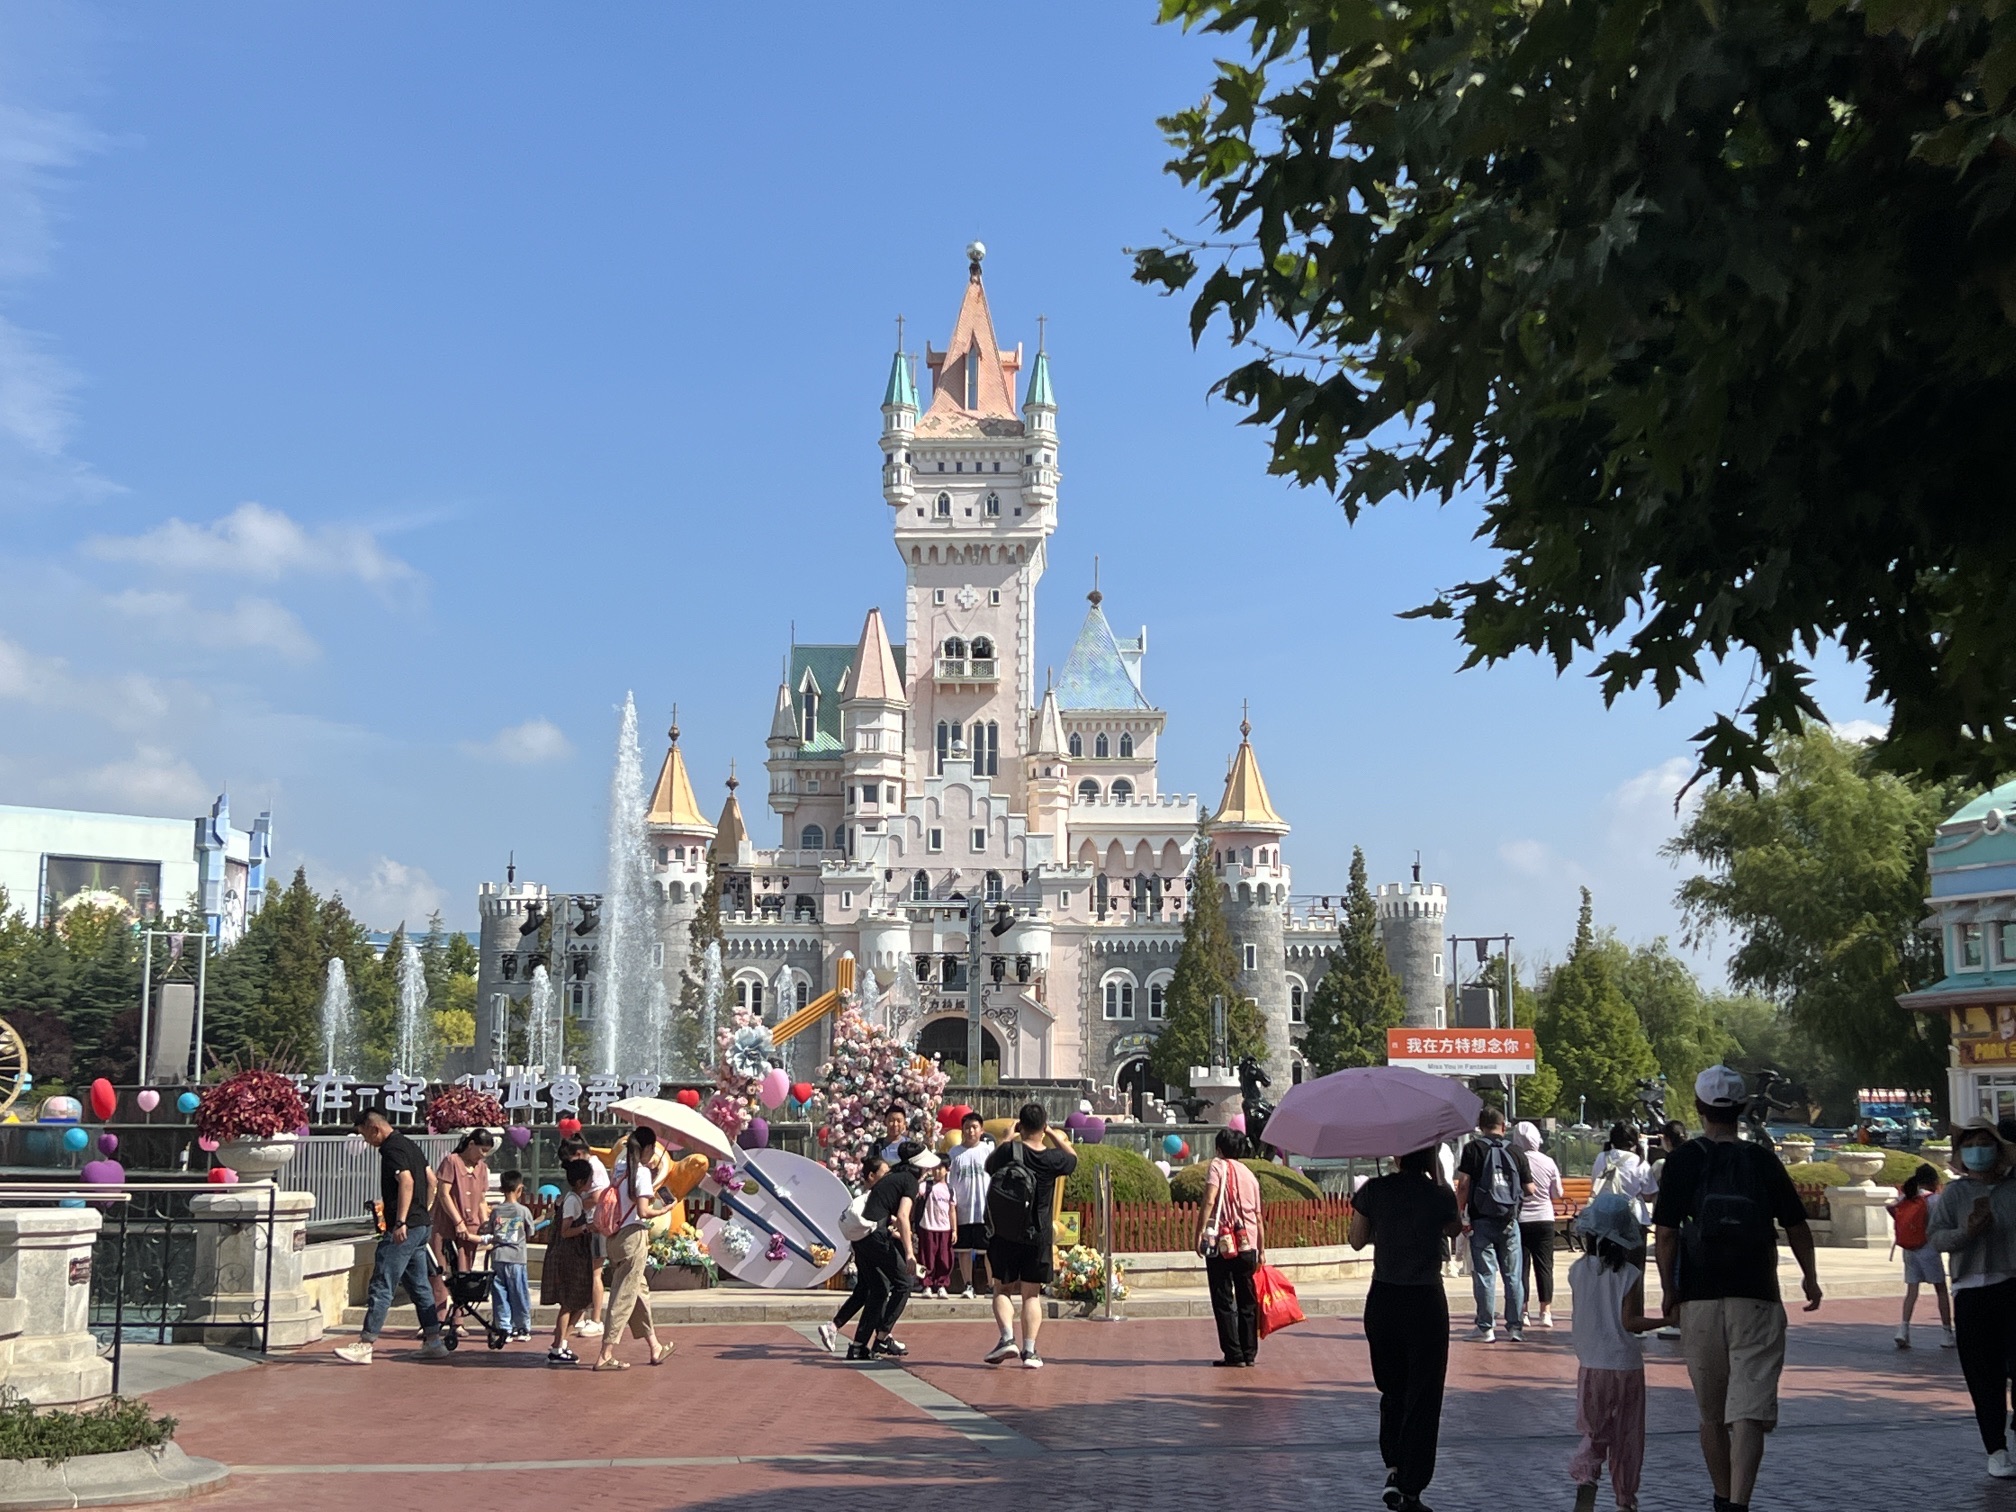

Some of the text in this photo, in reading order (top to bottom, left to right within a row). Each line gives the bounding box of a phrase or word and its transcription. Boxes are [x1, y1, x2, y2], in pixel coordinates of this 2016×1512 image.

[1406, 1037, 1519, 1054] 我在方特想念你
